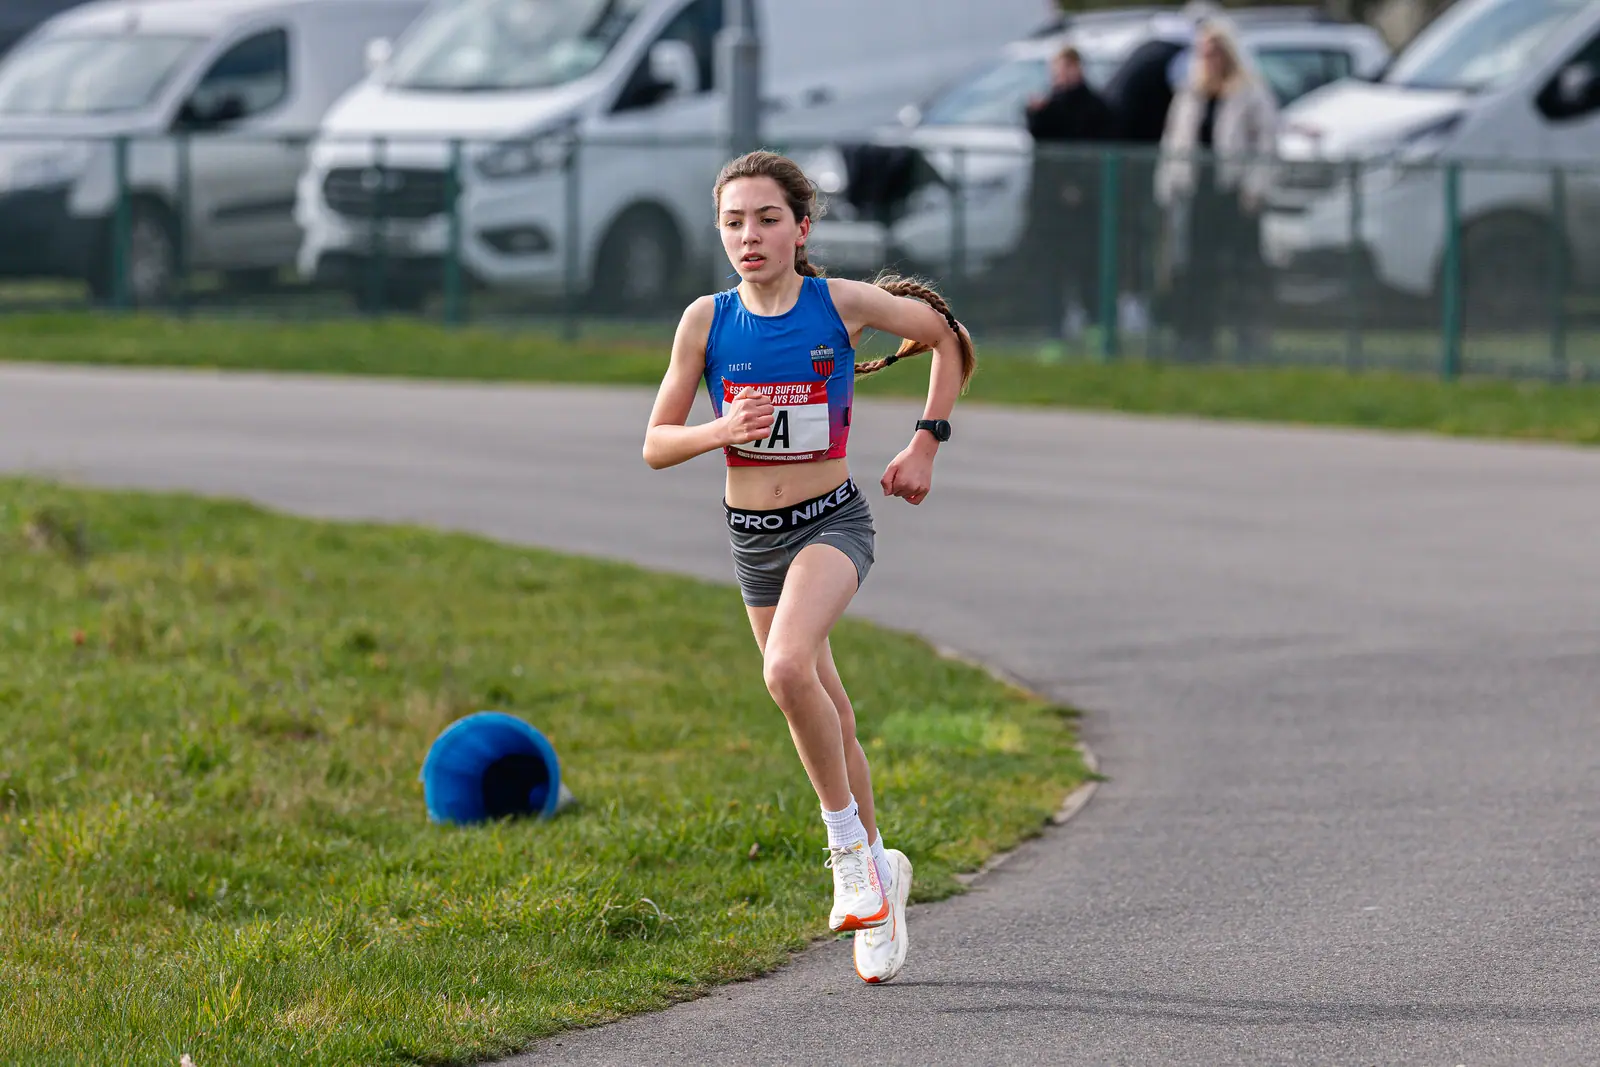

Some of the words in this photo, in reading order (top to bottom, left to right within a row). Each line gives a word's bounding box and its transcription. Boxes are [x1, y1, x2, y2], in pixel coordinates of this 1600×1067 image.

[728, 362, 752, 372] TACTIC
[729, 385, 755, 395] ESS
[756, 385, 774, 395] AND
[775, 384, 812, 395] SUFFOLK
[769, 394, 788, 404] AYS
[789, 394, 808, 404] 2026
[753, 410, 790, 448] A
[730, 512, 784, 530] PRO
[791, 481, 851, 526] NIKE
